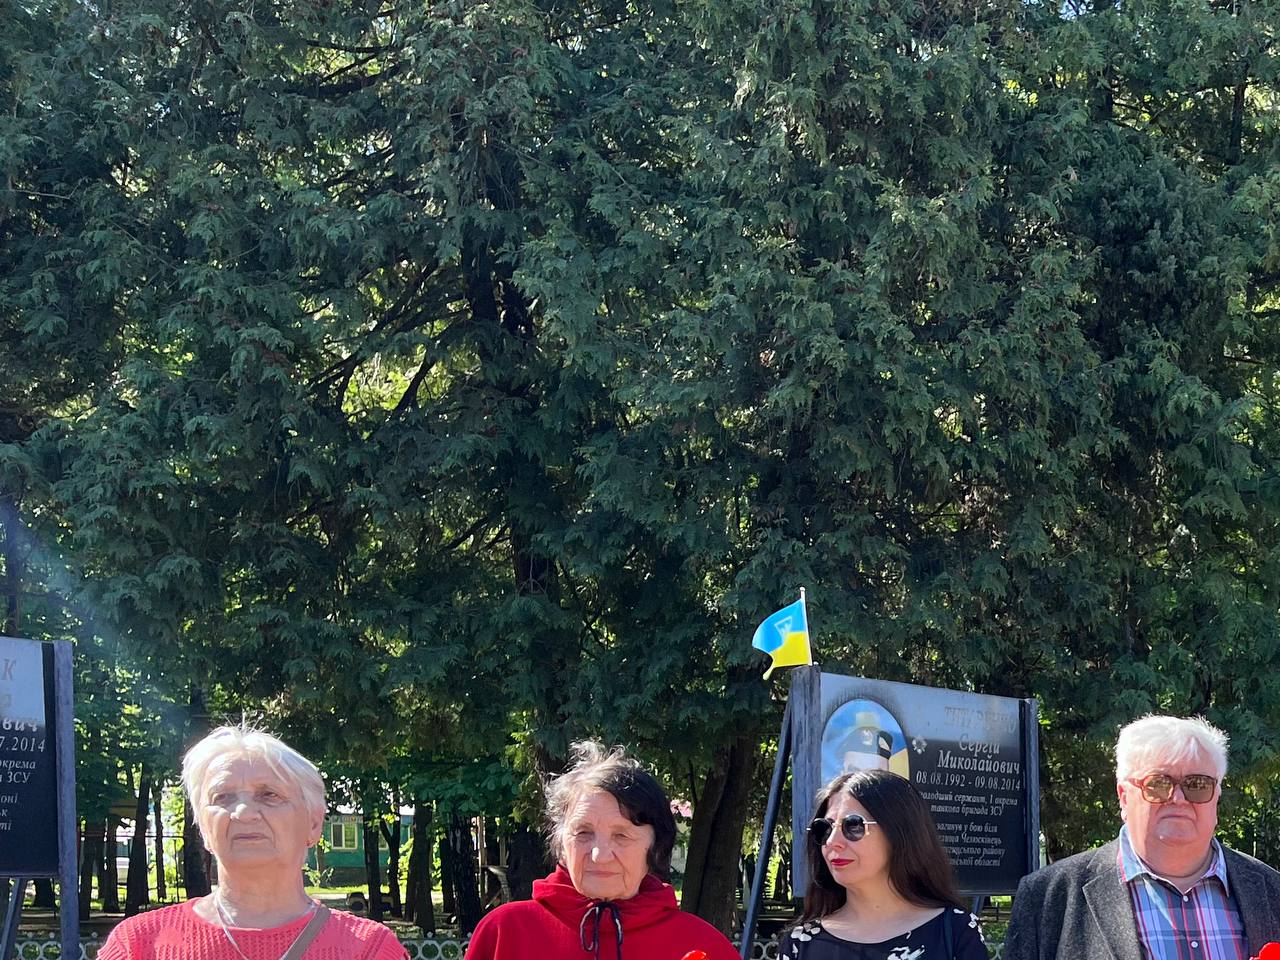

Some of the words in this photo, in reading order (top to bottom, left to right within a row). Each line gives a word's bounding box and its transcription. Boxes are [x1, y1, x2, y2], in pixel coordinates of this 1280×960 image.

[0, 759, 37, 771] крема
[937, 749, 1021, 775] Миколайович
[7, 771, 31, 783] ЗСУ
[916, 770, 966, 787] 08.08.1992
[974, 775, 1021, 791] 09.08.2014
